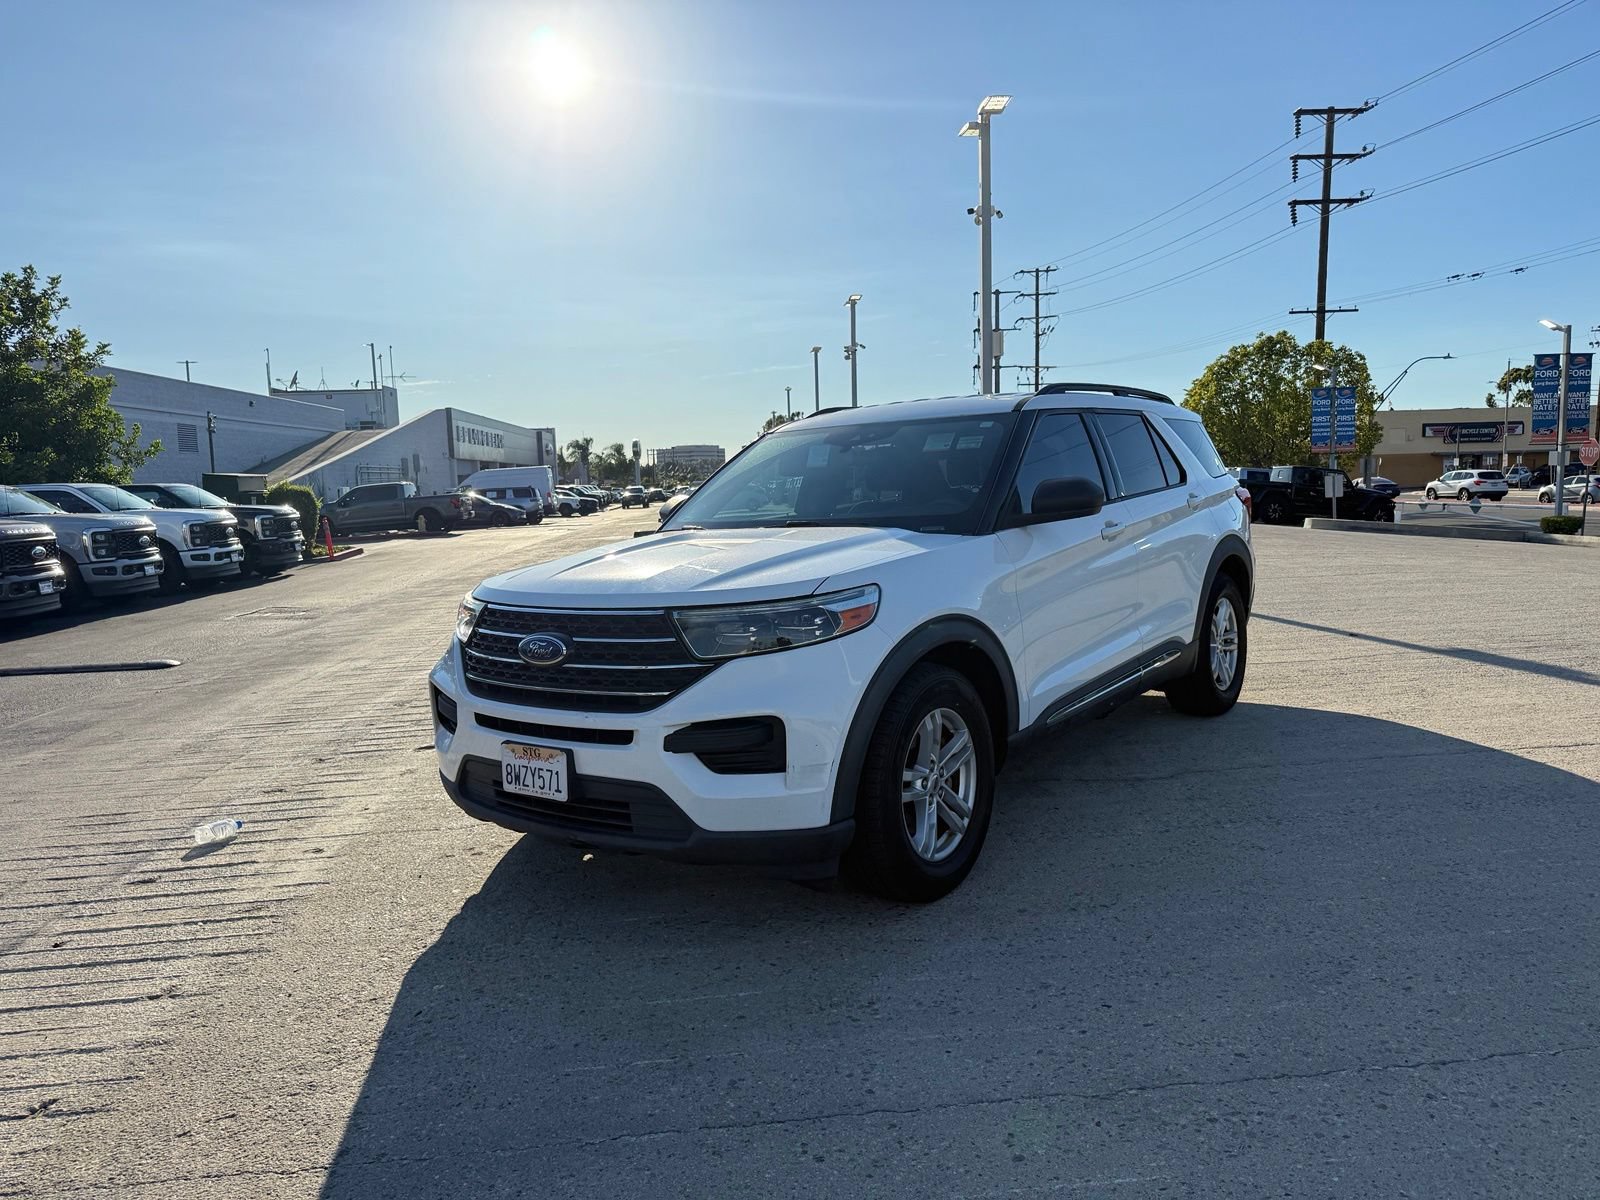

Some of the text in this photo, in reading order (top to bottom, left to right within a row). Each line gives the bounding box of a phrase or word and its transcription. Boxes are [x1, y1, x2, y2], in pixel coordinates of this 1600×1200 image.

[1581, 447, 1598, 458] STOP
[526, 640, 554, 658] Ford
[522, 746, 541, 758] STG
[506, 763, 562, 794] 8WZY571
